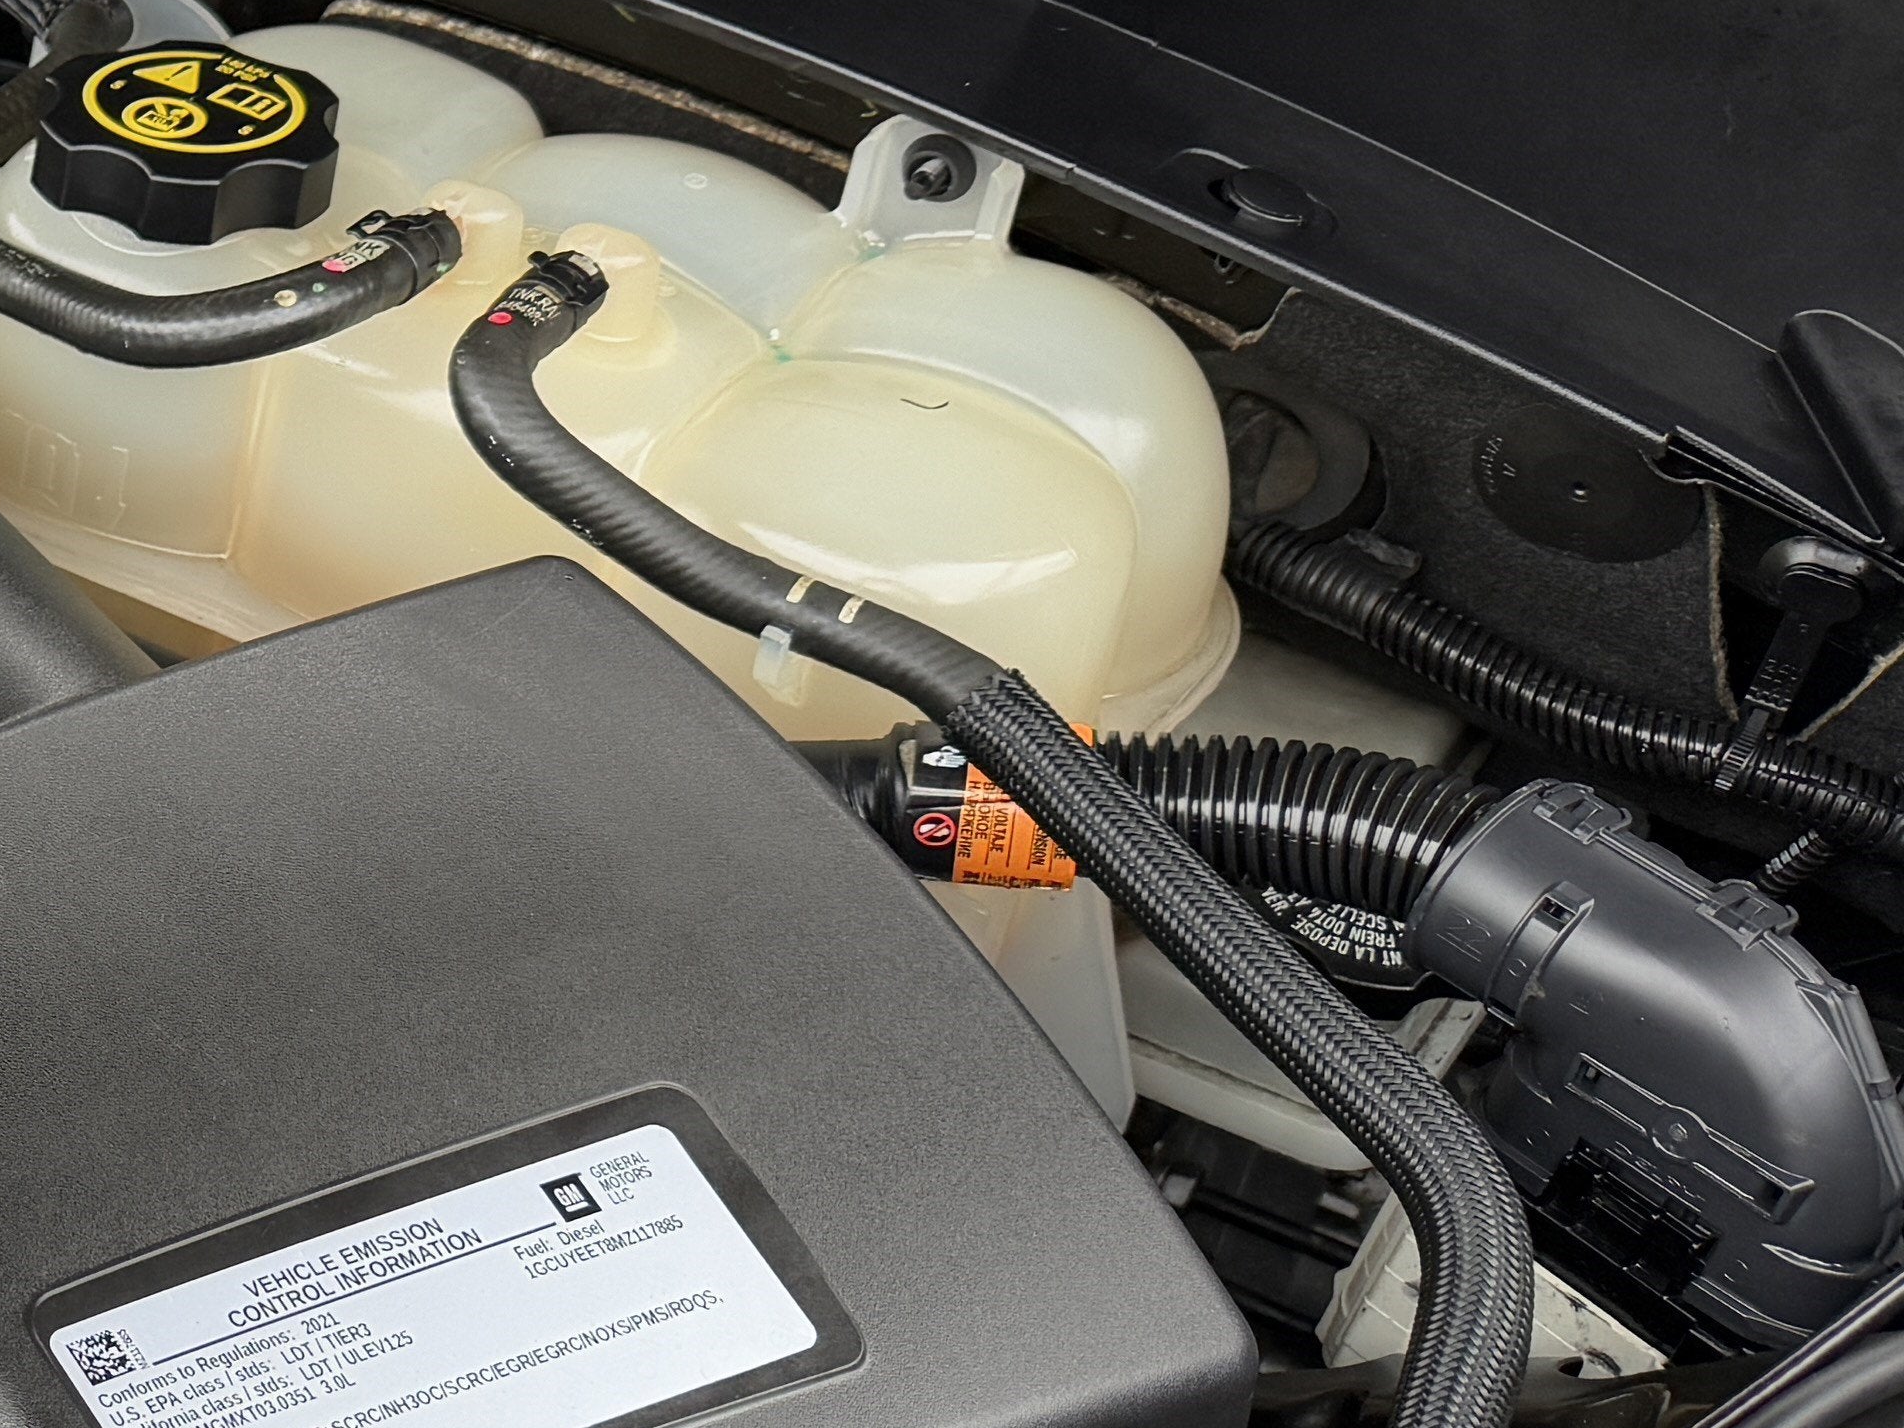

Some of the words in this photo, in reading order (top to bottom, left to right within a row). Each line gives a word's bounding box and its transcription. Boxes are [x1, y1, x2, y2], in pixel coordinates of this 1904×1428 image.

[992, 807, 1009, 853] VOLTAJE
[1348, 926, 1396, 948] FREIN
[1354, 944, 1376, 963] LA
[590, 1152, 649, 1178] GENERAL
[599, 1166, 652, 1191] MOTORS
[607, 1188, 634, 1204] LLC
[243, 1254, 339, 1297] VEHICLE
[339, 1218, 443, 1265] EMISSION
[513, 1238, 553, 1260] Fuel:
[556, 1220, 604, 1245] Diesel
[228, 1282, 335, 1327] CONTROL
[335, 1229, 482, 1290] INFORMATION
[98, 1373, 177, 1407] Conforms
[177, 1366, 195, 1379] to
[196, 1330, 295, 1372] Regulations:
[301, 1312, 340, 1334] 2021
[109, 1407, 145, 1426] U.S.
[145, 1392, 182, 1414] EPA
[183, 1378, 225, 1400] class
[235, 1360, 275, 1381] stds:
[281, 1342, 313, 1364] LDT
[322, 1323, 371, 1349] TIER3
[202, 1394, 243, 1415] class
[254, 1376, 293, 1396] stds:
[299, 1358, 332, 1380] LDT
[342, 1331, 413, 1364] ULEV125
[320, 1373, 356, 1393] 3.0L
